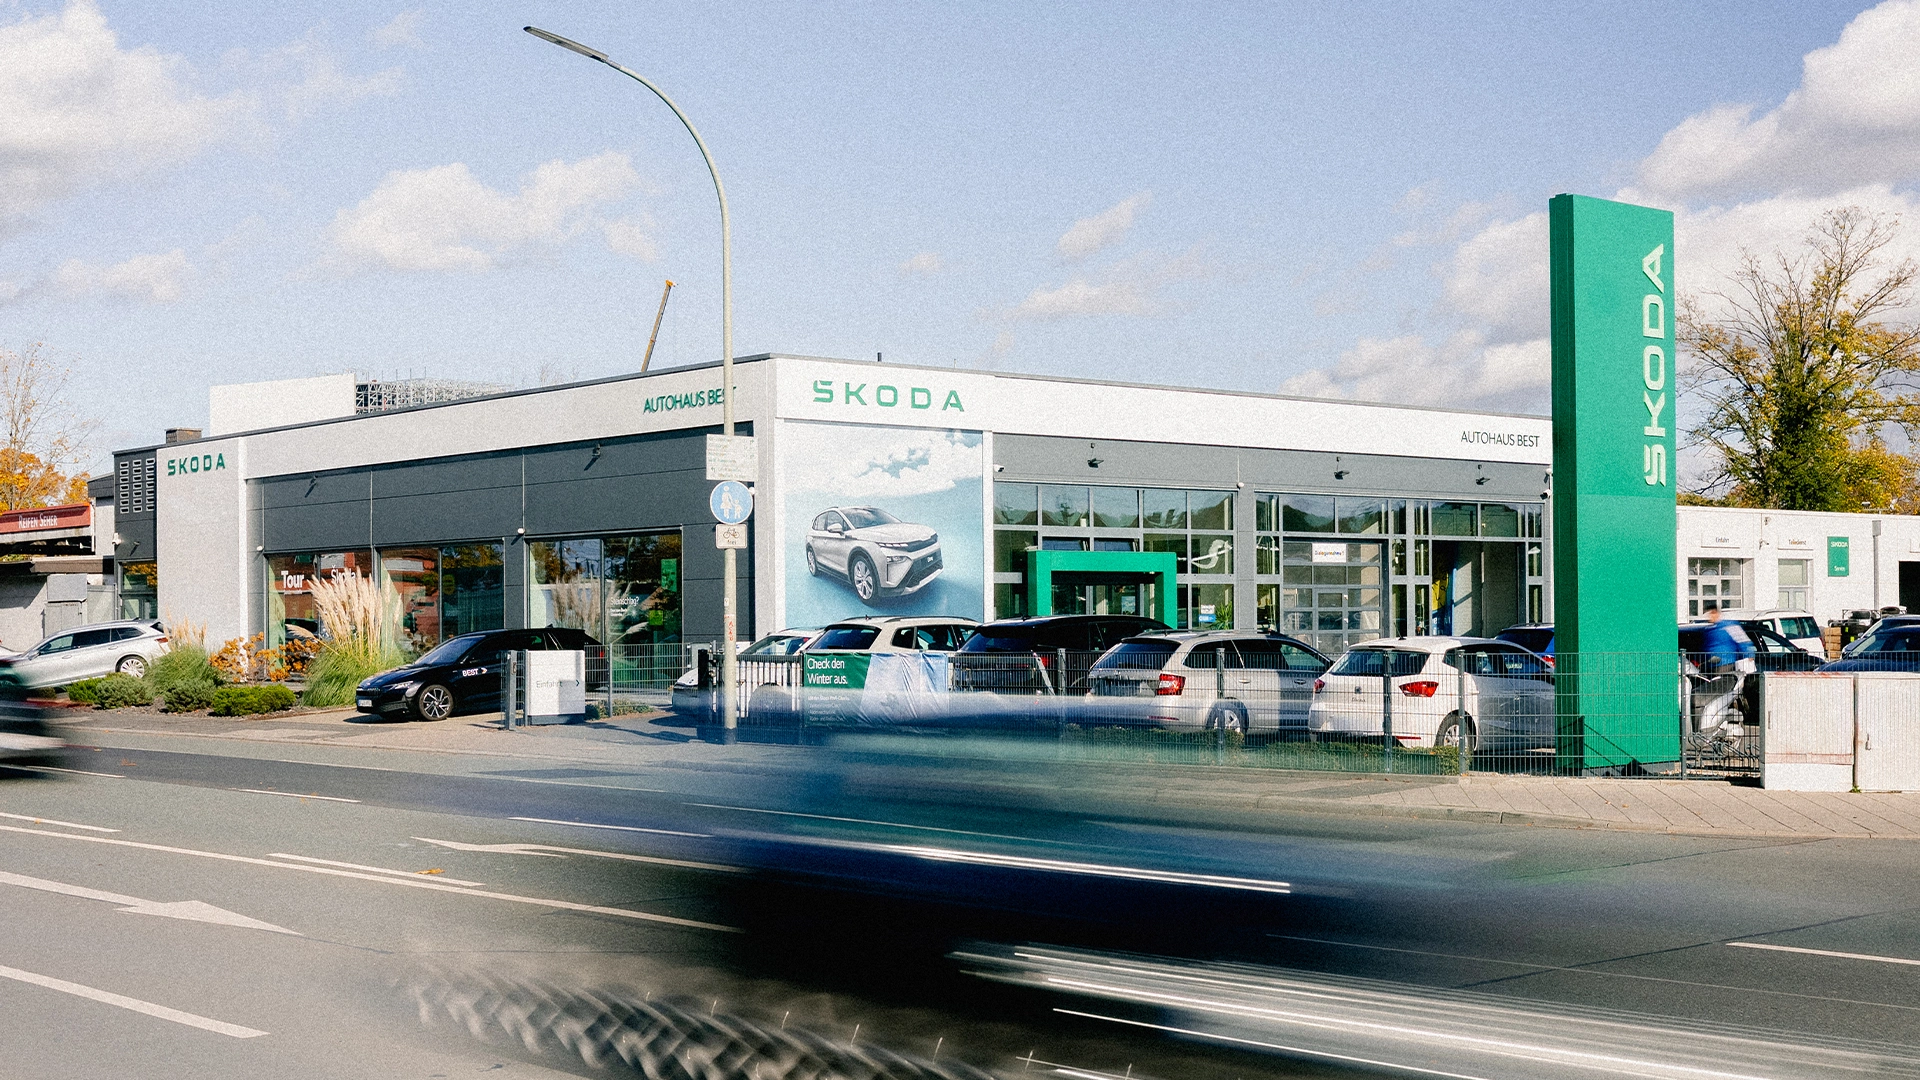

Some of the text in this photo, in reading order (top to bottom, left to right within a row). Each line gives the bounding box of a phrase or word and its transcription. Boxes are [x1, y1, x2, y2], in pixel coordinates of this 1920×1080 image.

[1642, 243, 1666, 487] SKODA
[643, 386, 737, 414] AUTOHAUS BE
[812, 380, 965, 412] SKODA
[1460, 430, 1540, 448] AUTOHAUS BEST
[167, 453, 226, 476] SKODA
[281, 570, 305, 589] Tour
[462, 668, 479, 677] BEST
[807, 657, 845, 670] Check den
[807, 673, 849, 685] Winter aus.
